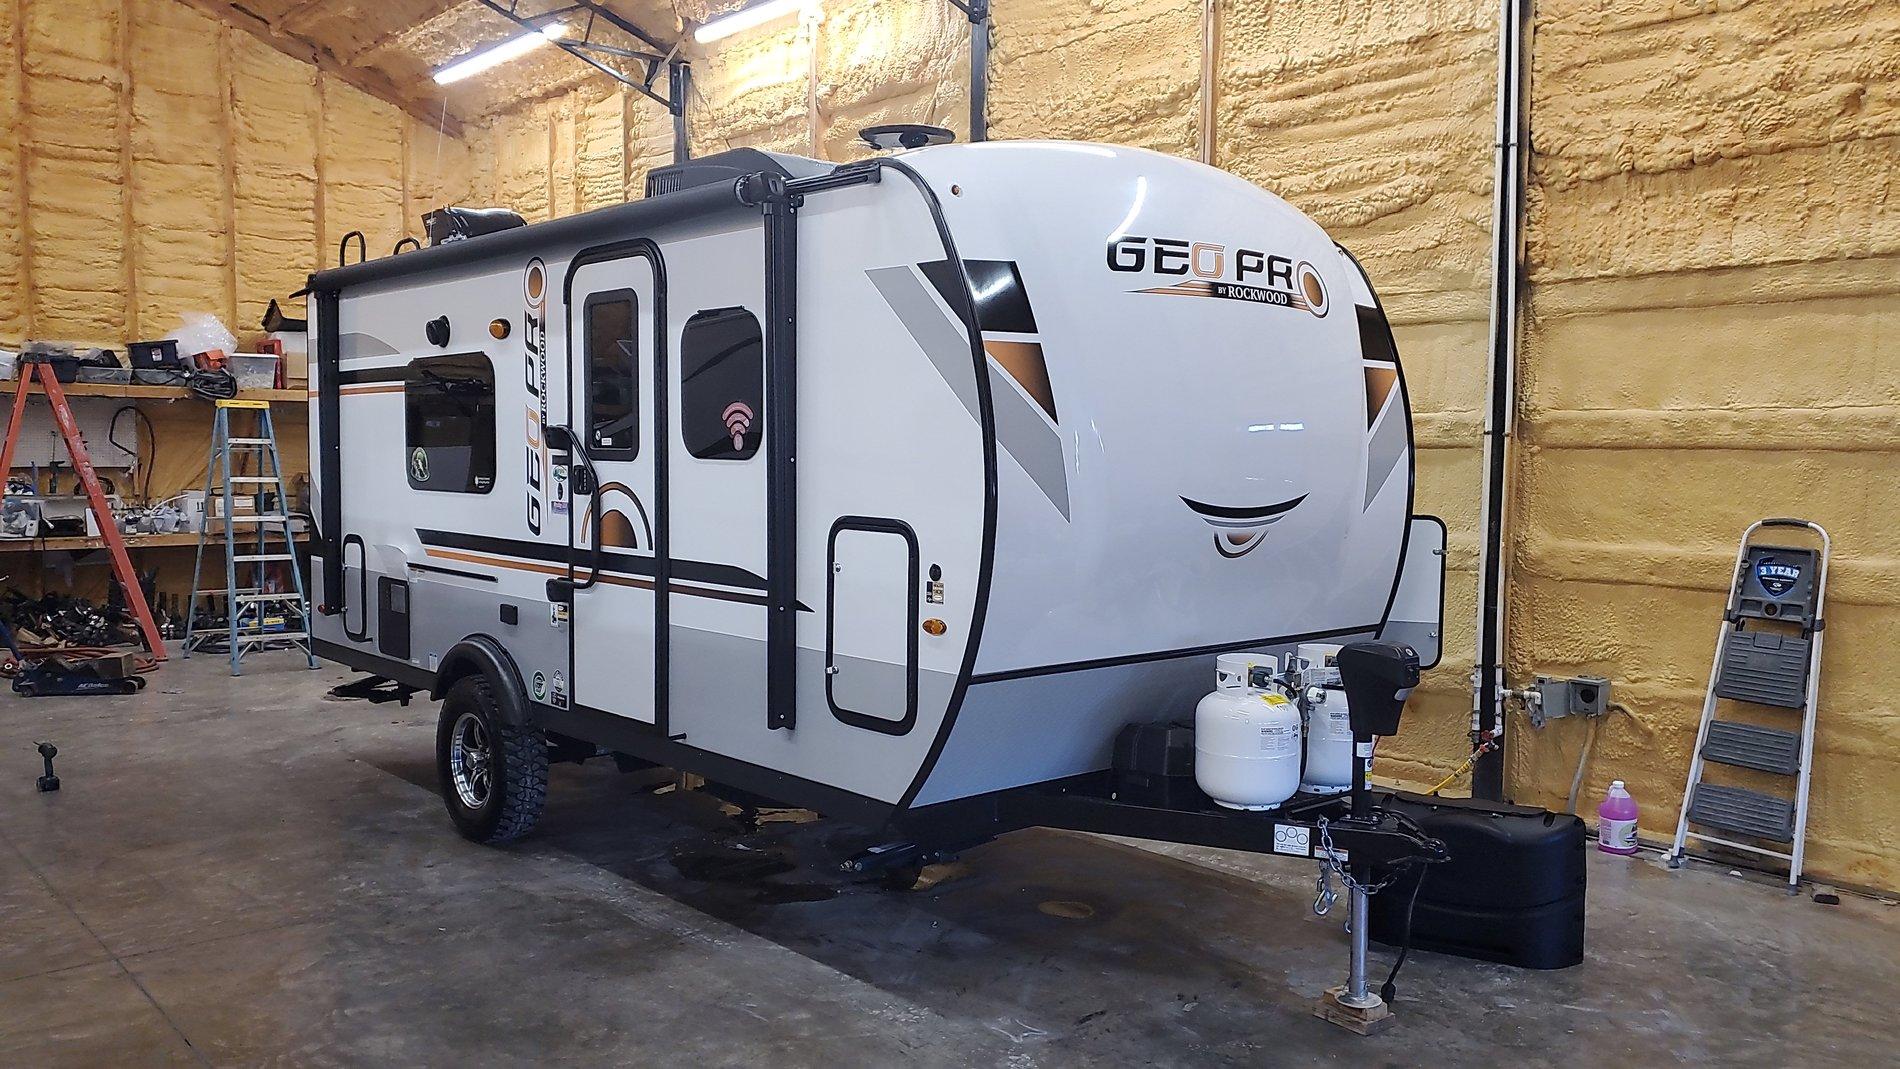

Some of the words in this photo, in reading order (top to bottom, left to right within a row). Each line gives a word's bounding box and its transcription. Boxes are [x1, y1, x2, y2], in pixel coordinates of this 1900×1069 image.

[1106, 235, 1225, 279] GEO
[1236, 249, 1330, 318] PRO
[1217, 286, 1227, 295] BY
[1228, 285, 1288, 305] ROCKWOOD
[523, 256, 547, 398] PRO
[541, 413, 546, 425] BY
[525, 404, 541, 536] GEO
[1760, 566, 1767, 575] 3
[1770, 565, 1800, 578] YEAR
